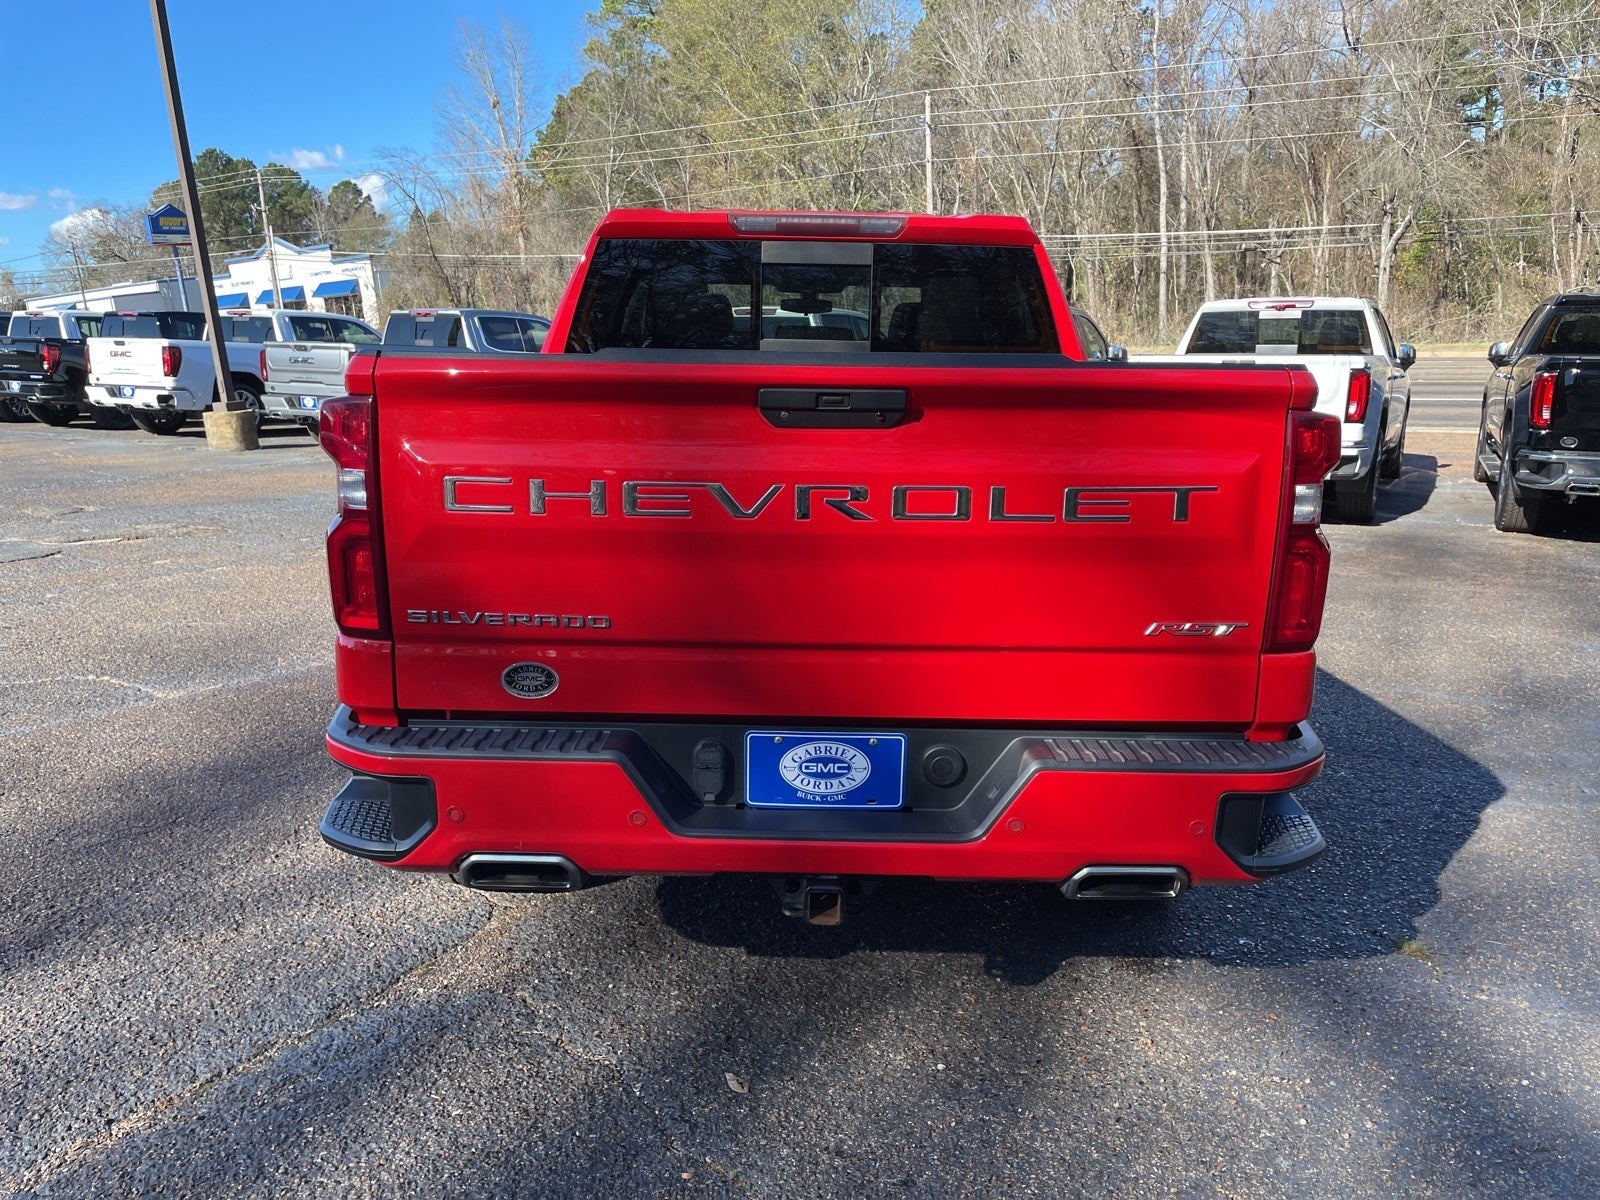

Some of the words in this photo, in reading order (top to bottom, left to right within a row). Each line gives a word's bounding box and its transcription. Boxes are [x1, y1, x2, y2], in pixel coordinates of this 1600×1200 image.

[289, 356, 315, 364] GMC
[443, 475, 1219, 523] CHEVROLET
[406, 609, 612, 629] SILVERADO
[1144, 622, 1249, 636] RST
[510, 666, 549, 677] GABRIEL
[511, 682, 549, 691] JORDAN
[791, 745, 858, 764] GABRIEL
[801, 762, 849, 773] GMC
[791, 774, 857, 790] JORDAN
[796, 791, 821, 801] BUICK
[827, 793, 847, 801] GMC
